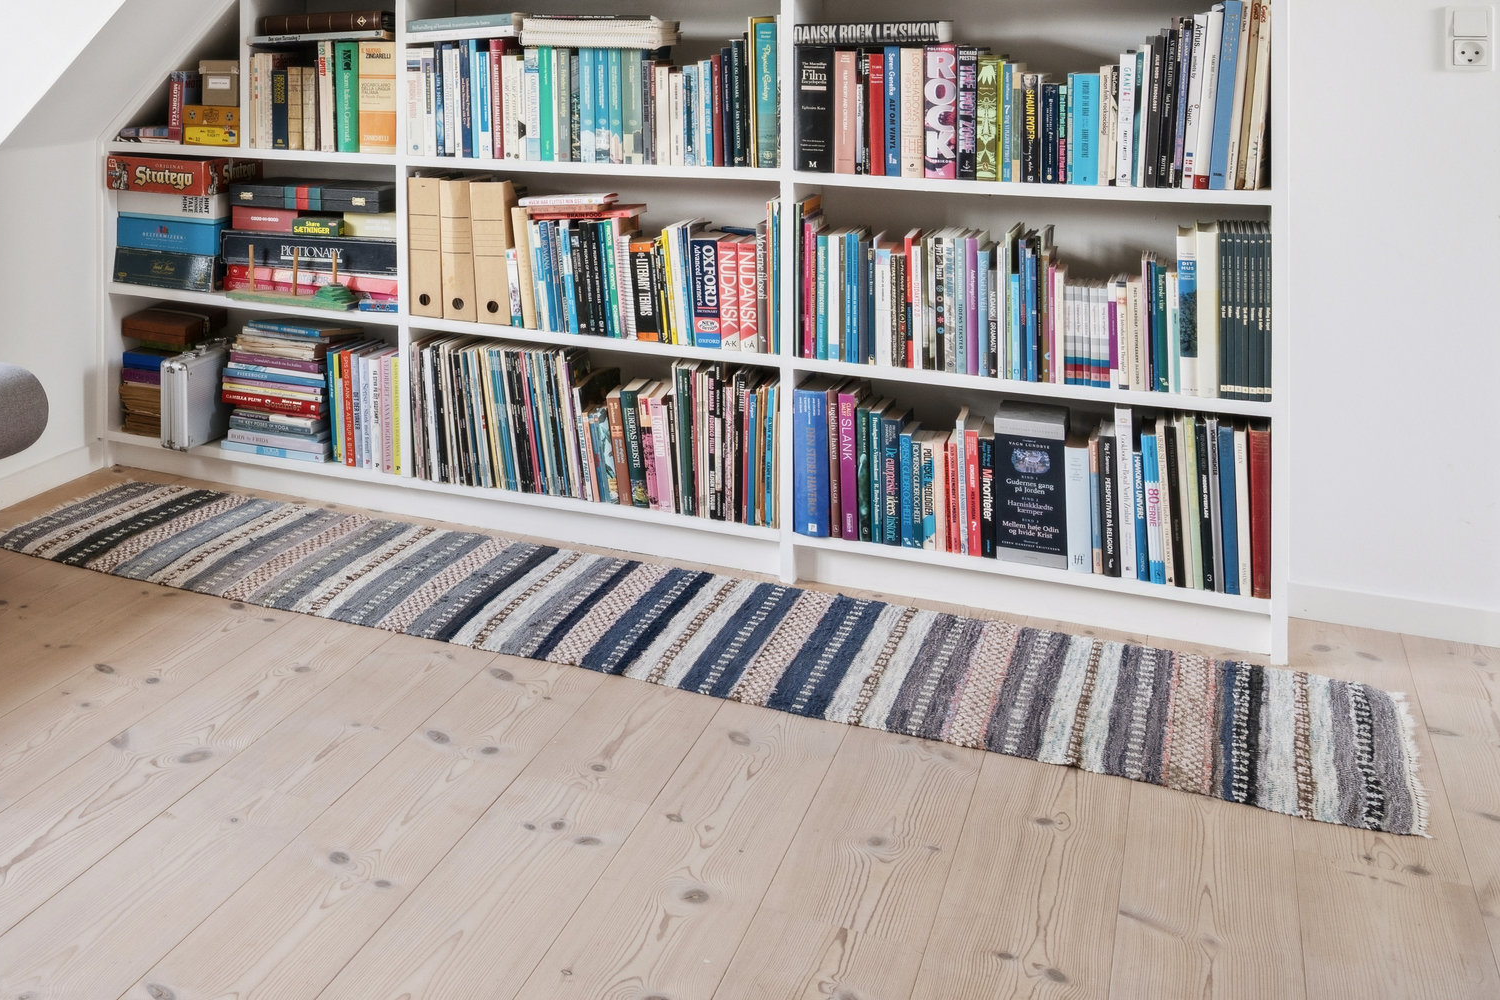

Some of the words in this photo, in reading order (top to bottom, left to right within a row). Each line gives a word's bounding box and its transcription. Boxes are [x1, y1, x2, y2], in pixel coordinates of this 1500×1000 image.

[794, 25, 838, 45] DANSK
[839, 24, 874, 44] ROCK
[875, 22, 940, 43] LEKSIKON
[1193, 23, 1205, 54] Århus...
[761, 44, 771, 74] Physical
[888, 53, 896, 70] Søren
[762, 74, 772, 102] Geology
[801, 67, 827, 81] Film
[888, 71, 896, 96] Genefke
[959, 63, 976, 89] THE
[924, 51, 956, 159] ROCK
[959, 91, 976, 119] HOT
[1025, 89, 1035, 115] SHAUN
[889, 114, 896, 125] OM
[1026, 116, 1035, 140] RYDER
[1101, 102, 1109, 136] rocksociologi
[959, 120, 976, 154] ZONE
[133, 165, 194, 191] Stratego
[142, 232, 186, 240] BEZZERWIZZER
[293, 226, 330, 234] SÆTNINGER
[693, 244, 702, 277] Advanced
[756, 234, 767, 271] Moderne
[636, 258, 650, 288] LITERARY
[702, 244, 717, 307] OXFORD
[757, 274, 767, 300] filosofi
[638, 289, 653, 316] TERMS
[695, 277, 703, 307] Learner's
[719, 250, 738, 329] NUDANSK
[738, 251, 757, 331] NUDANSK
[627, 407, 638, 440] EUROPAS
[652, 415, 665, 457] LORTELAND
[841, 418, 852, 461] SLANK
[885, 447, 897, 457] De
[631, 440, 641, 469] BEDSTE
[912, 444, 920, 475] ROMERSKE
[923, 448, 933, 480] POLITISKE
[883, 457, 898, 495] europæiske
[1005, 478, 1037, 488] Gudernes
[1038, 483, 1055, 491] gang
[1134, 455, 1142, 490] HAWKINGS
[913, 496, 921, 506] OG
[924, 480, 934, 516] IDEOLOGIER
[981, 468, 993, 521] Minoriteter
[1024, 487, 1045, 495] Jorden
[1104, 477, 1113, 519] PERSPEKTIVER
[1135, 490, 1144, 520] UNIVERS
[886, 495, 898, 516] ideers
[913, 509, 921, 524] HELTE
[1007, 500, 1054, 512] Harniskklædte
[1017, 507, 1044, 516] kæmper
[886, 516, 899, 541] historie
[1002, 520, 1026, 529] Mellem
[1027, 523, 1042, 531] høje
[1042, 525, 1059, 534] Odin
[1008, 528, 1017, 536] og
[1018, 528, 1036, 537] hvide
[1037, 531, 1053, 539] Krist
[1105, 519, 1114, 527] PÅ
[1106, 527, 1114, 555] RELIGION
